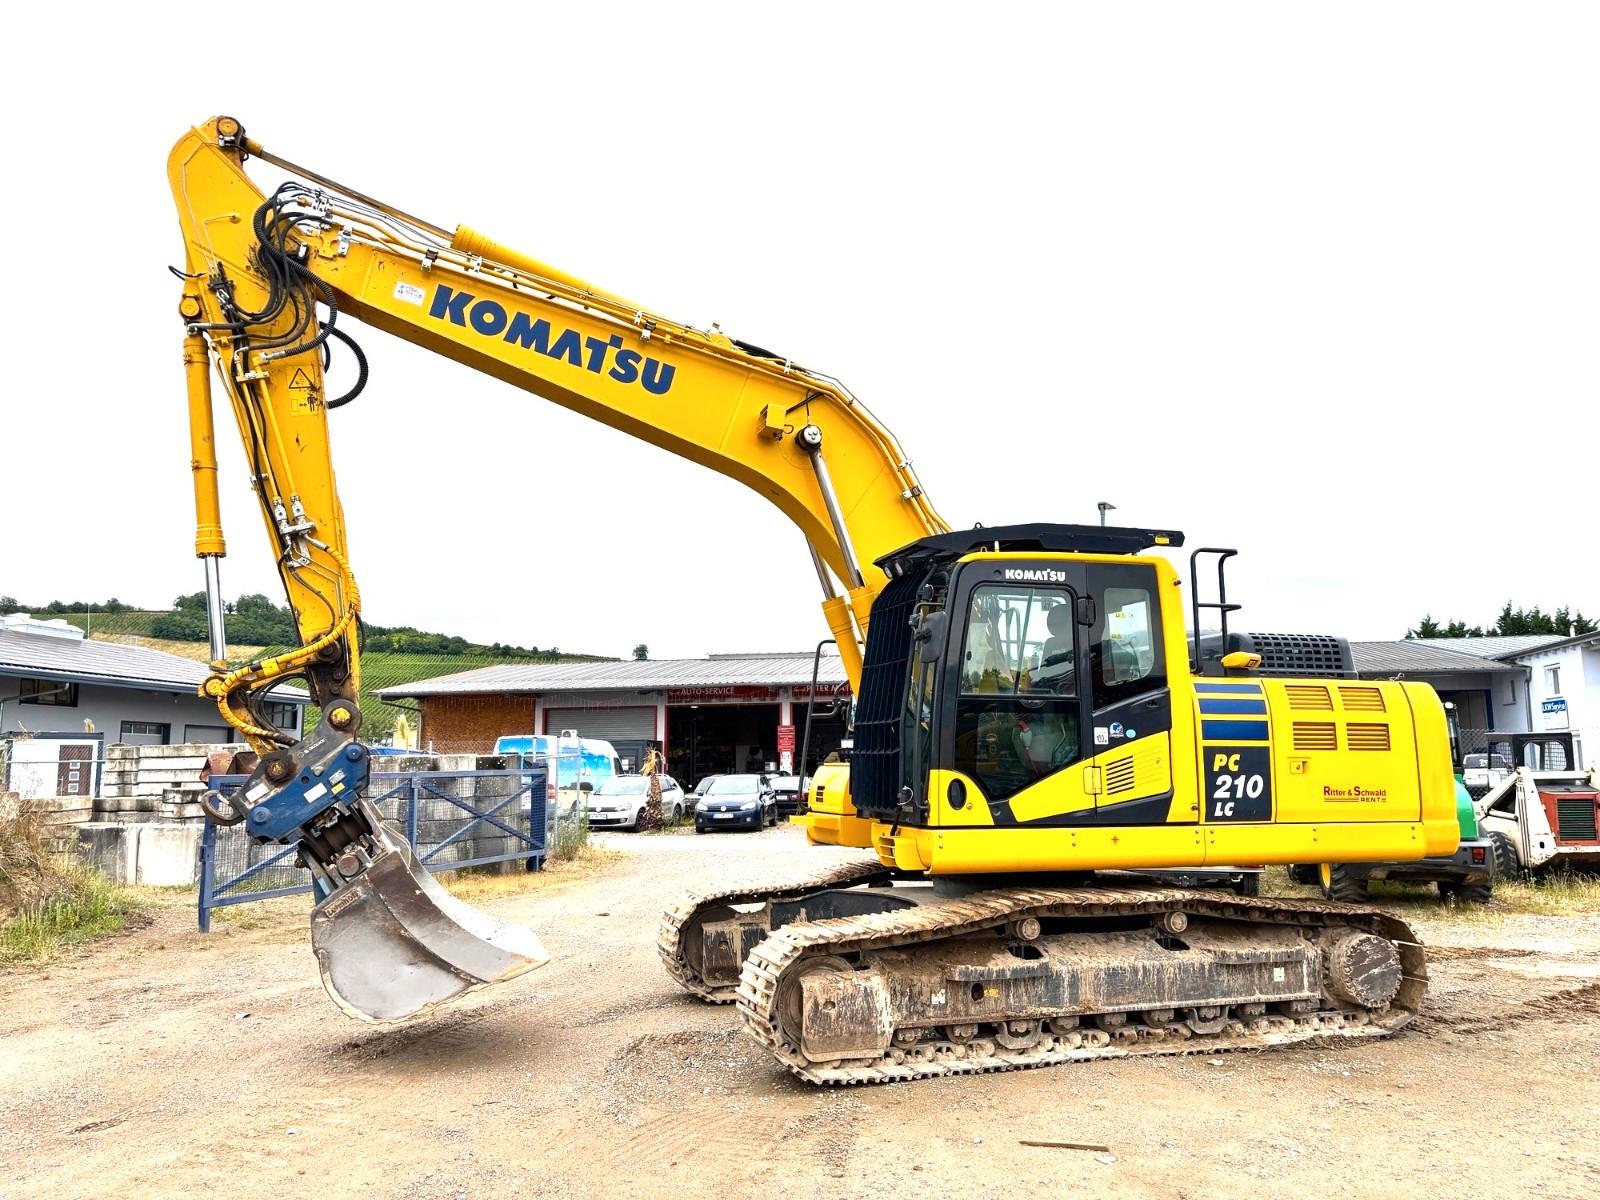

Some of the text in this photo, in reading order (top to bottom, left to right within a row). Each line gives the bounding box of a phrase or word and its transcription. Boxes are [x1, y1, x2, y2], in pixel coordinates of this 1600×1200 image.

[429, 283, 676, 395] KOMATSU
[1005, 568, 1066, 581] KOMATSU
[680, 686, 735, 695] AUTO-SERVICE
[1213, 753, 1240, 771] PC
[1213, 774, 1264, 799] 210
[1323, 785, 1346, 796] Ritter
[1354, 785, 1387, 796] Schwald
[1214, 801, 1235, 817] LC
